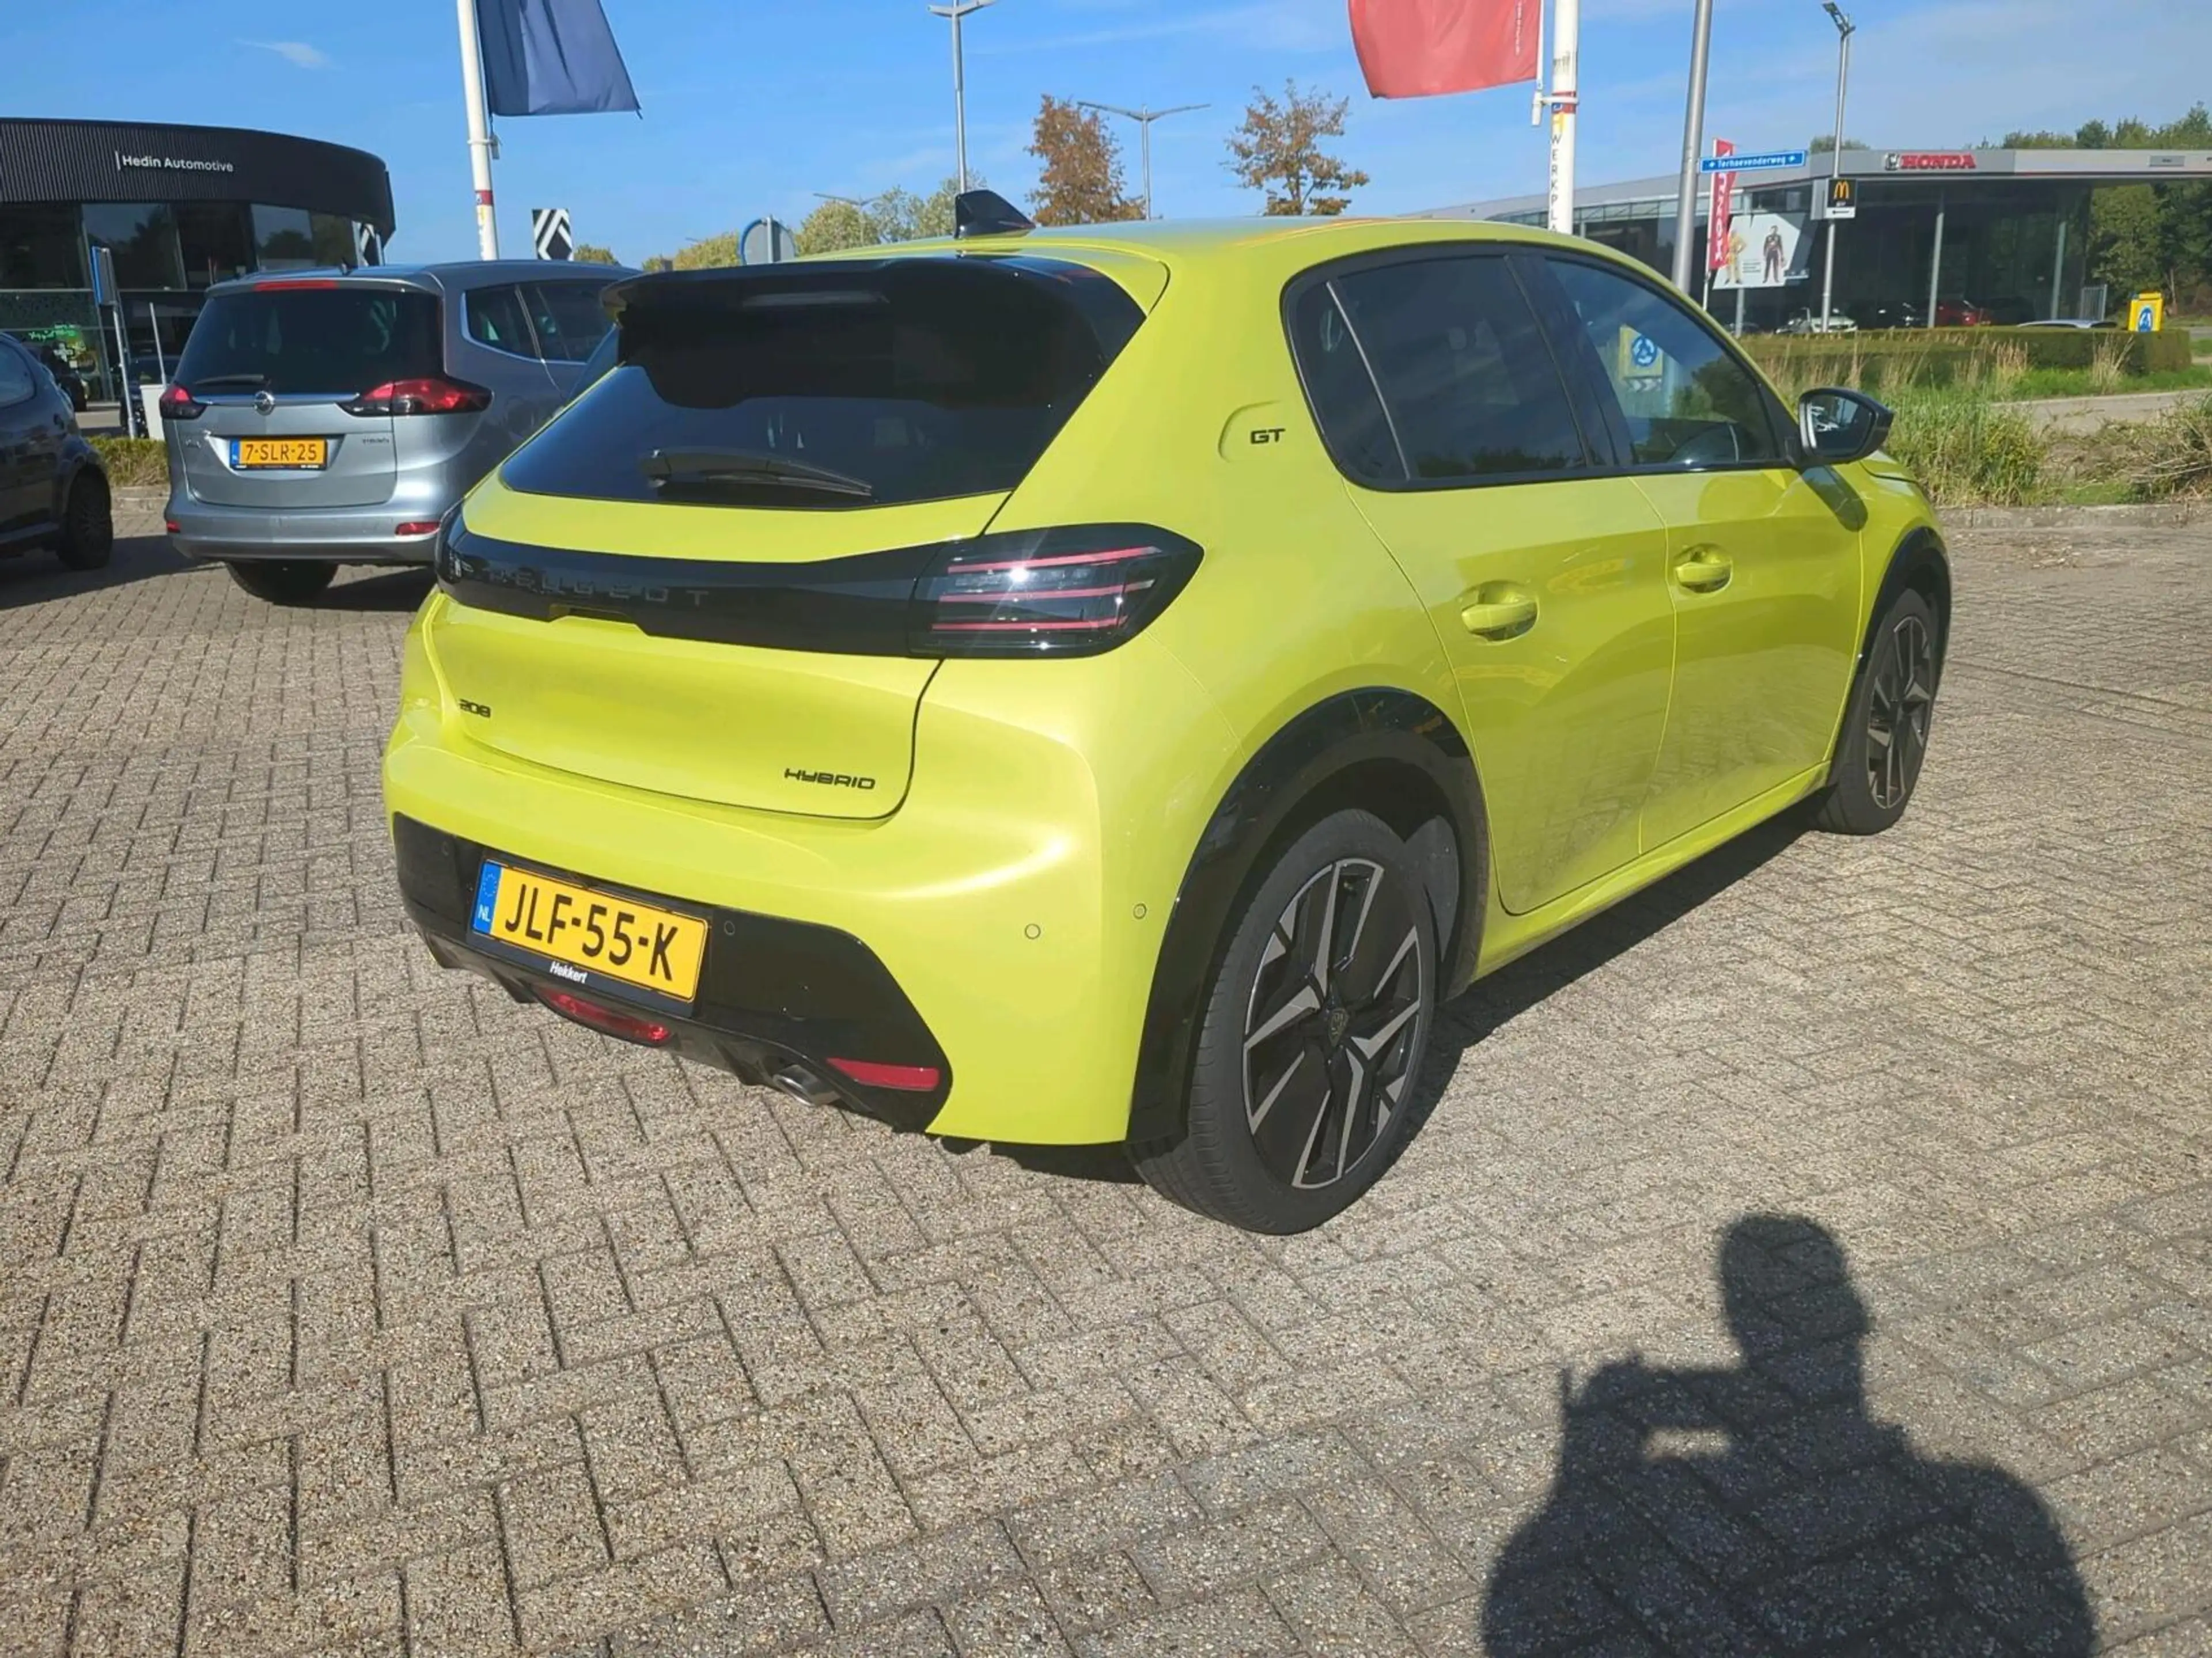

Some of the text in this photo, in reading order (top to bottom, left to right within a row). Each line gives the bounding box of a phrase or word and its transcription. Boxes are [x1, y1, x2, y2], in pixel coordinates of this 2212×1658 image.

[122, 154, 234, 172] Hedin Automotive
[1900, 154, 1977, 169] HONDA
[1250, 428, 1286, 445] GT
[245, 442, 317, 462] 7-SLR-25
[459, 697, 491, 719] 208
[783, 768, 876, 790] HYBRID
[477, 903, 491, 923] NL
[504, 883, 679, 981] JLF-55-K
[549, 960, 589, 985] Hekkert
